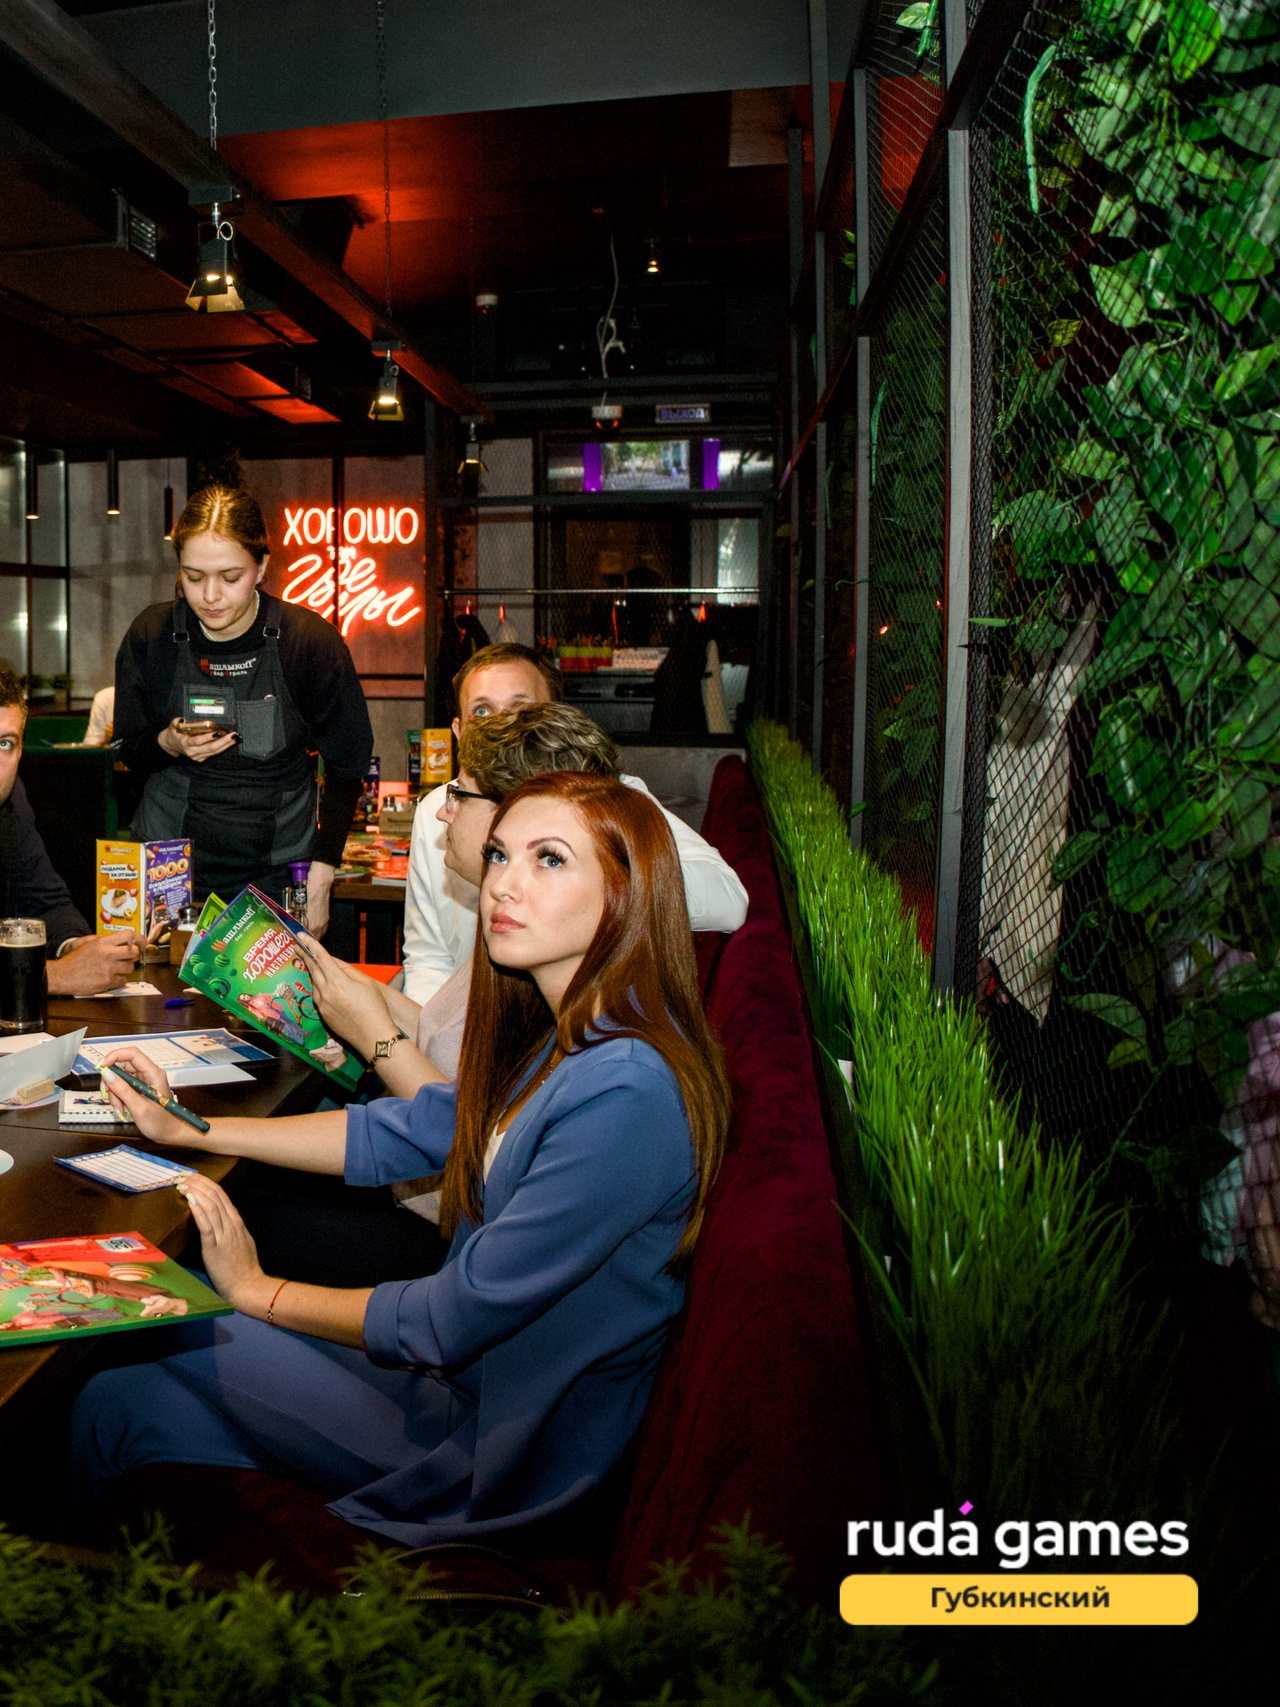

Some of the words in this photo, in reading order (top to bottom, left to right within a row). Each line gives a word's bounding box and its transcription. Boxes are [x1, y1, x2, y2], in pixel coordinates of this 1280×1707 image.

[282, 506, 420, 547] ХОРОШО
[147, 858, 189, 883] 1000
[242, 928, 277, 963] ВРЕМЯ
